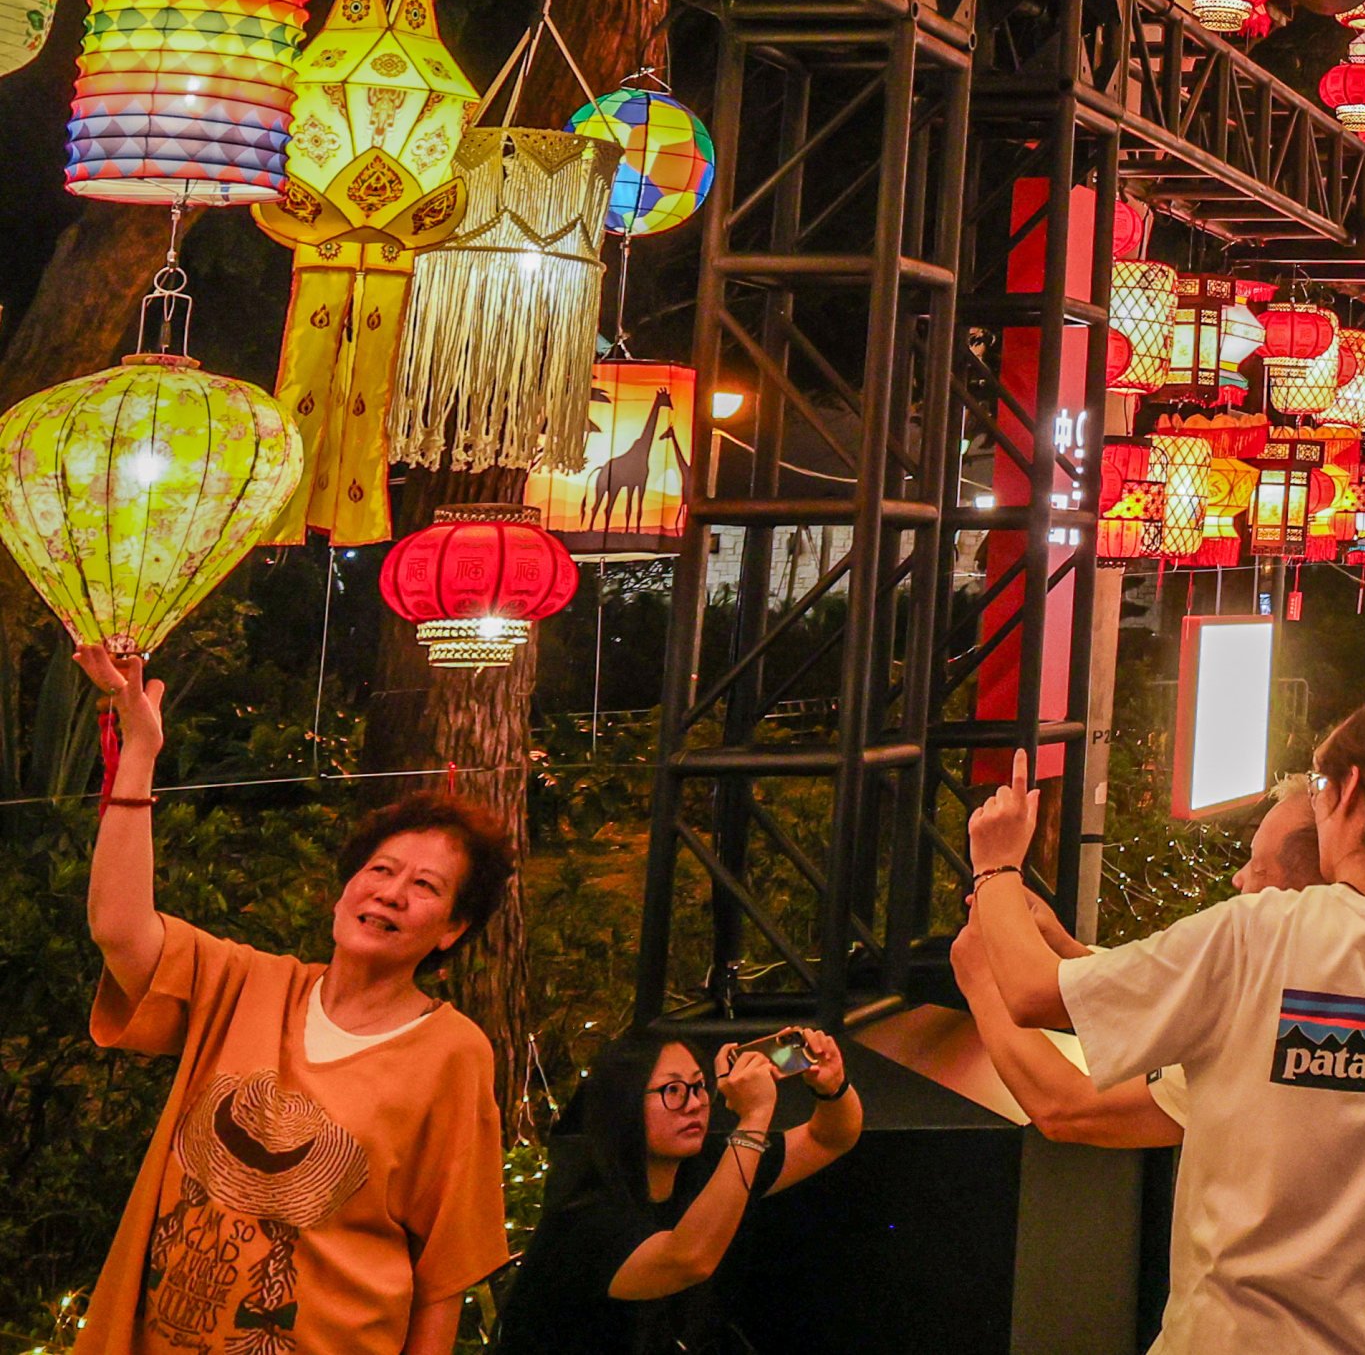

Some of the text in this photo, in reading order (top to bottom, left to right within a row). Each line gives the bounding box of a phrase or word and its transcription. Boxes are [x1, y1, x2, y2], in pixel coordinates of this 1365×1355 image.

[455, 557, 485, 582] 福
[514, 557, 540, 582] 福
[229, 1219, 256, 1243] SO
[185, 1225, 240, 1263] GLAD
